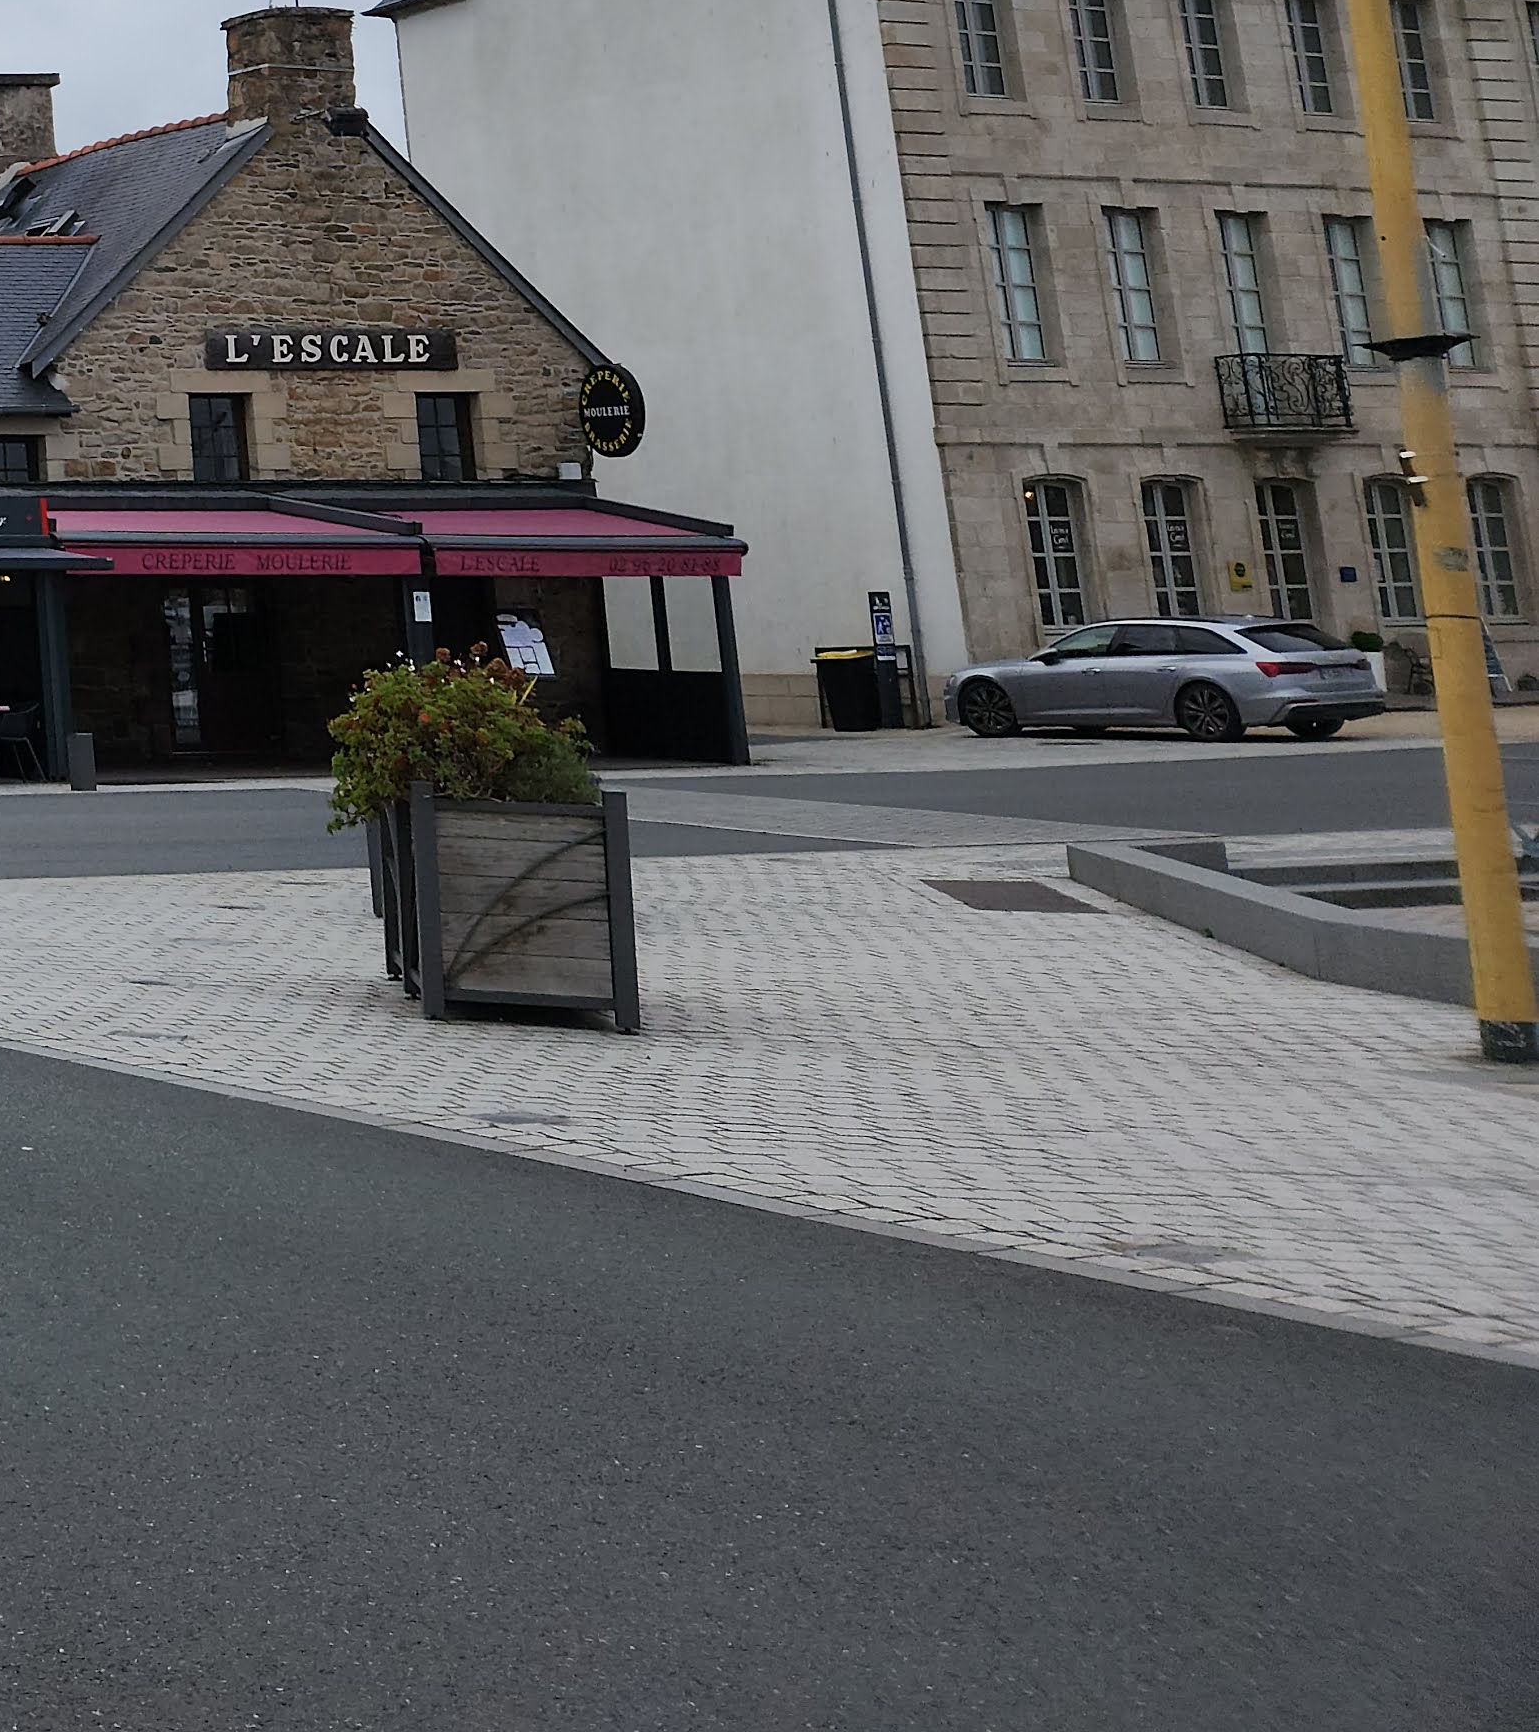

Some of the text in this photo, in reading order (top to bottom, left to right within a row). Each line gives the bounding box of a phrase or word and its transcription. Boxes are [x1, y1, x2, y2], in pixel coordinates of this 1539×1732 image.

[225, 334, 430, 363] L'ESCALE
[584, 405, 631, 418] MOULERIE
[584, 418, 632, 452] BRASSERIE
[142, 553, 352, 571] CREPERIE MOULERIE
